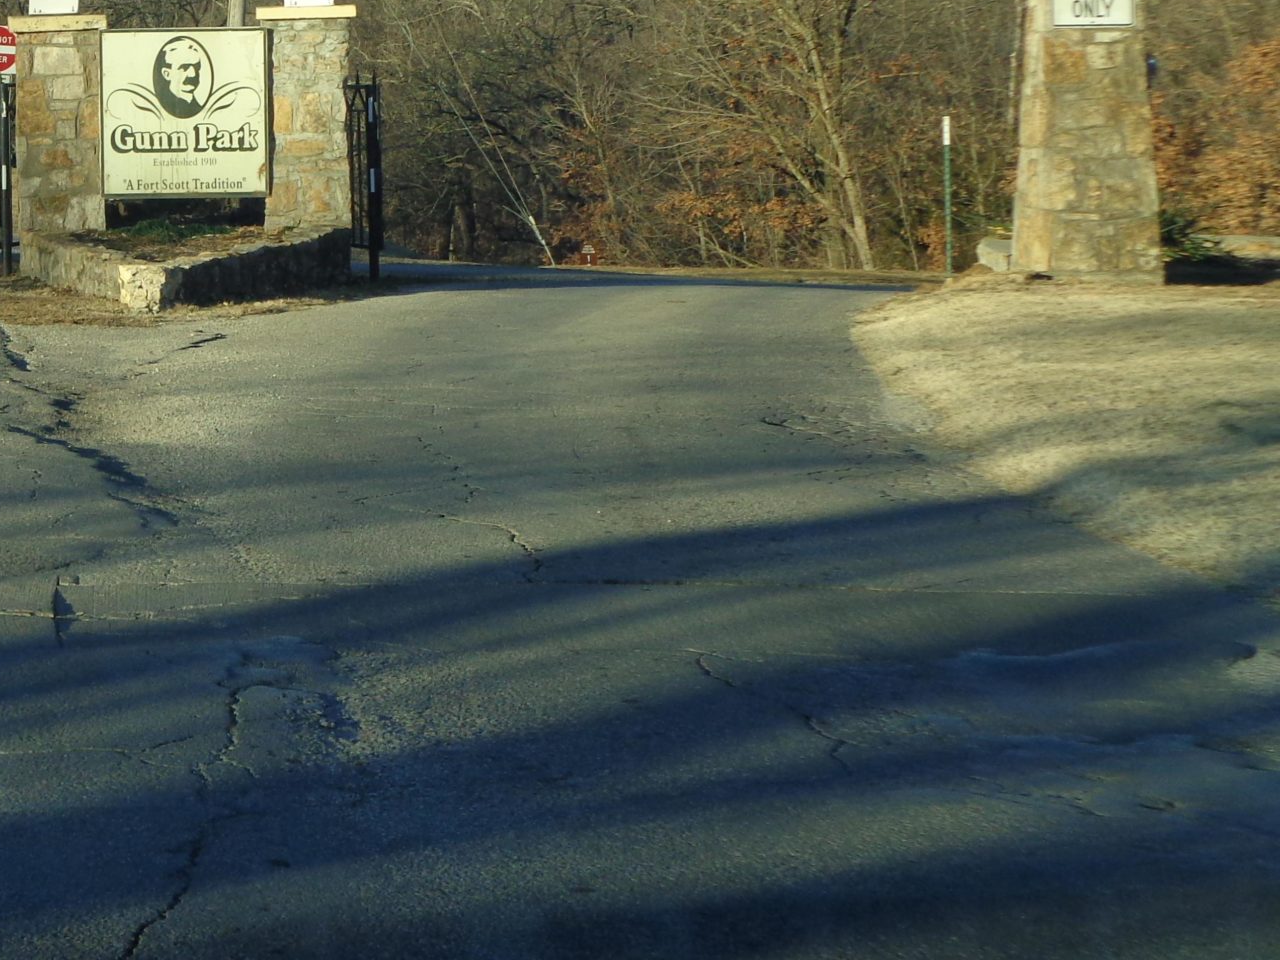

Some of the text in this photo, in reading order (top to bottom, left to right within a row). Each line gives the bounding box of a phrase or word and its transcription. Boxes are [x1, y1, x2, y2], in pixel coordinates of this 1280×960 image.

[1072, 0, 1115, 18] ONLY
[111, 122, 259, 154] Gunn Park
[152, 156, 218, 167] Established 1910
[137, 178, 159, 191] Fort
[161, 178, 190, 191] Scott
